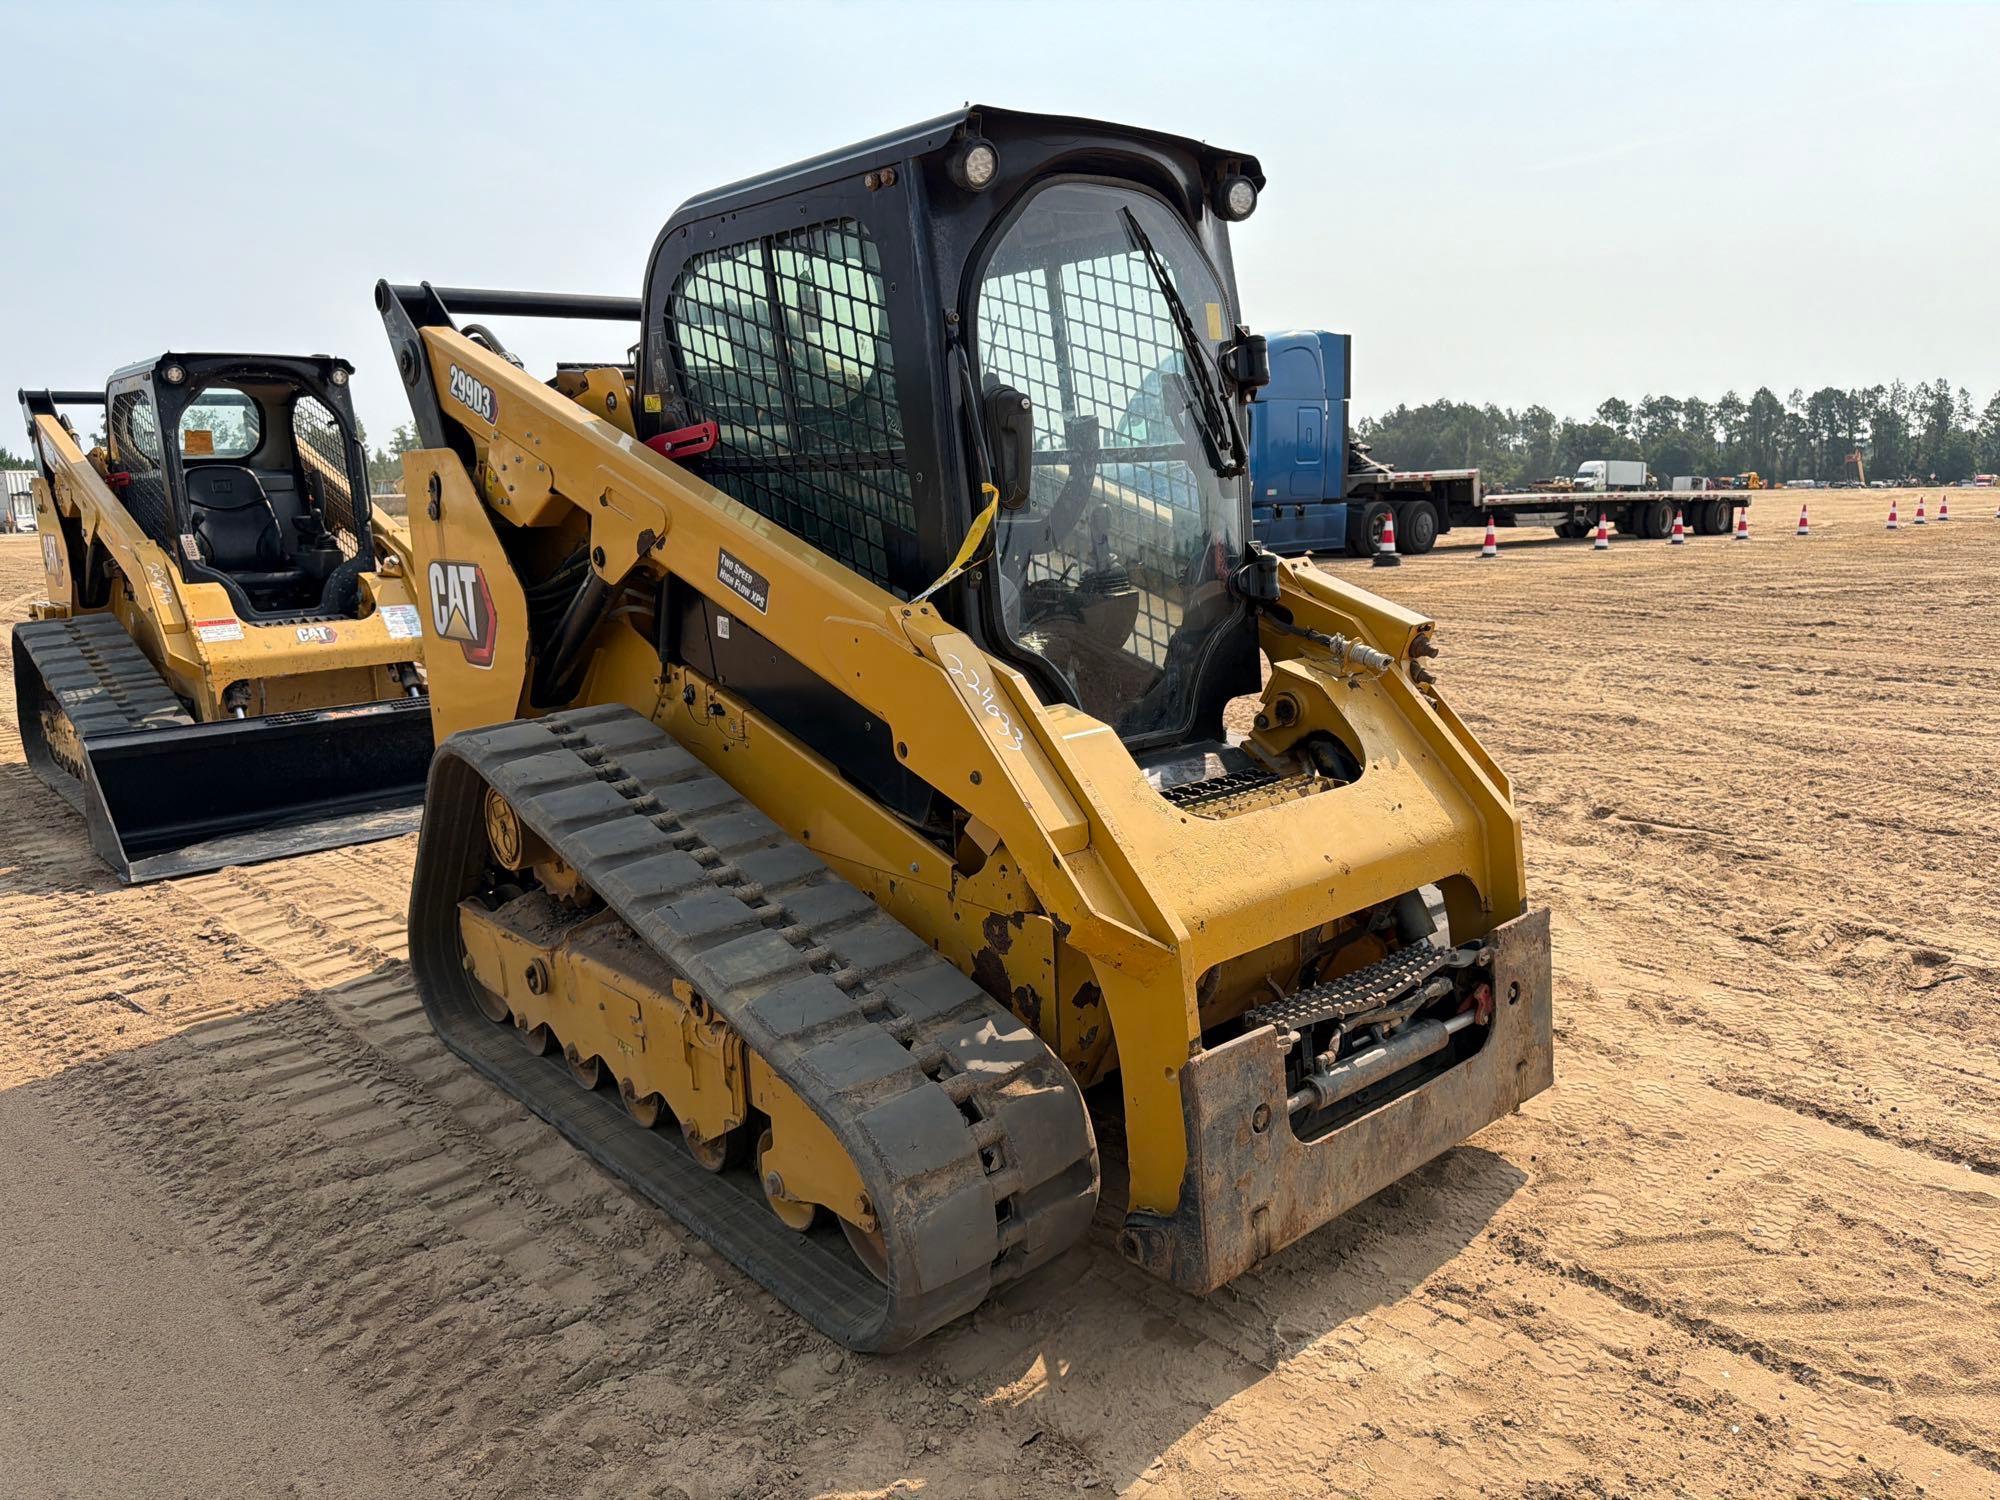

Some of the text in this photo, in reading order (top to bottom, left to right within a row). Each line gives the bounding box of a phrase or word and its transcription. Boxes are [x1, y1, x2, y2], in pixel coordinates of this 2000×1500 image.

[450, 364, 491, 419] 299D3
[428, 562, 479, 641] CAT
[751, 590, 766, 608] XPS
[296, 626, 329, 642] CAT
